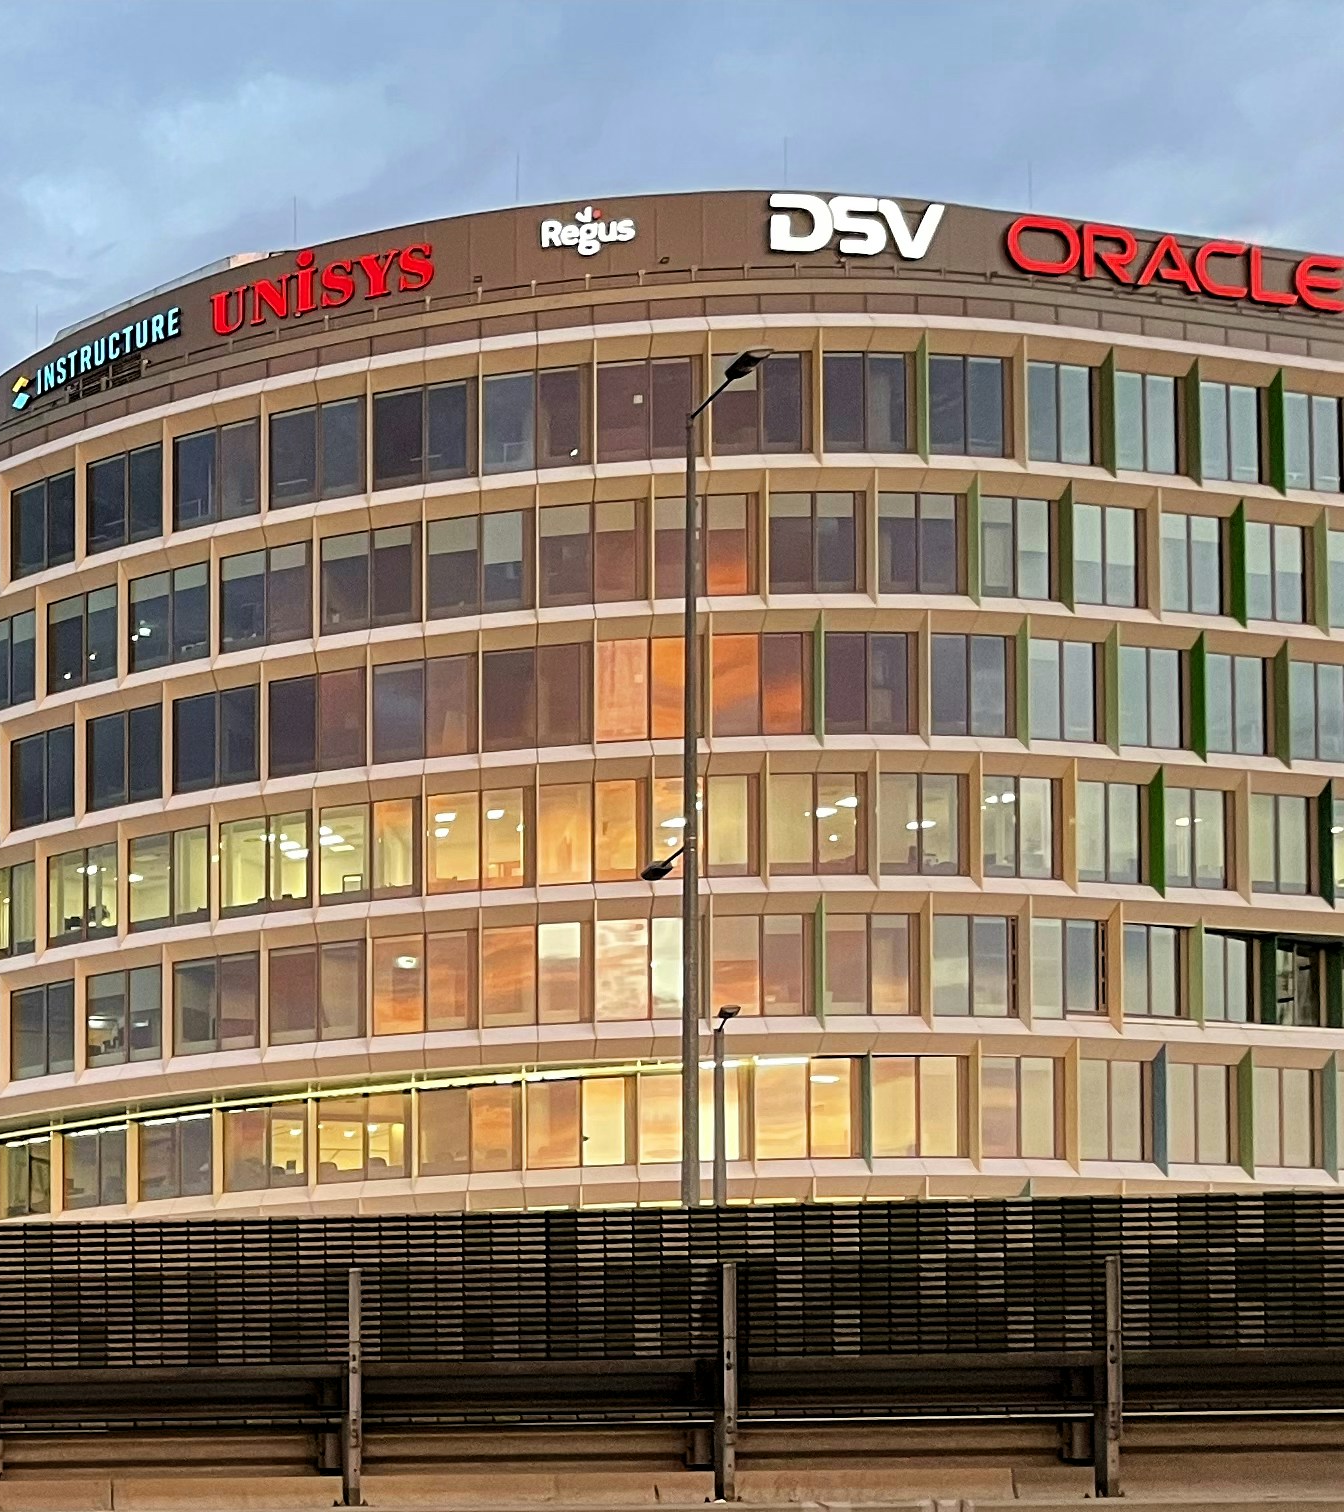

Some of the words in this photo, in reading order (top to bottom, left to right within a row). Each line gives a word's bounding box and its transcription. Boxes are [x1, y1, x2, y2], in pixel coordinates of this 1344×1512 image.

[541, 216, 636, 256] Regus
[769, 193, 946, 260] DSV
[1006, 214, 1344, 313] ORACLE
[35, 306, 181, 396] INSTRUCTURE
